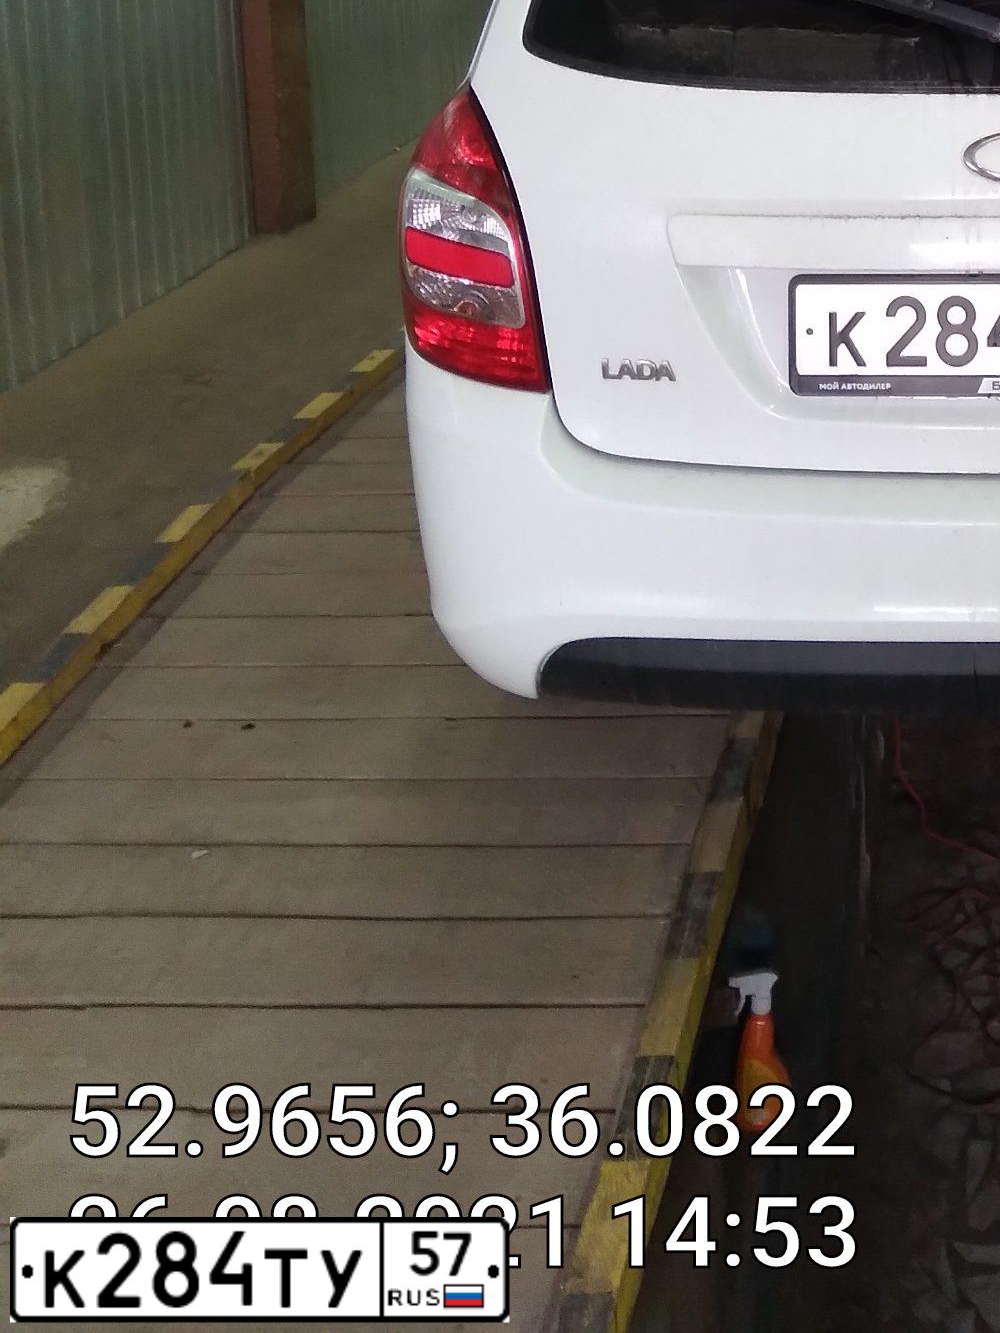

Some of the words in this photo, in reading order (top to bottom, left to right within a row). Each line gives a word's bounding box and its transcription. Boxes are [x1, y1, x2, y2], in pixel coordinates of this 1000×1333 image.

[601, 358, 676, 381] LADA
[819, 381, 839, 390] МОЙ
[841, 383, 891, 391] АВТОДИЛЕР
